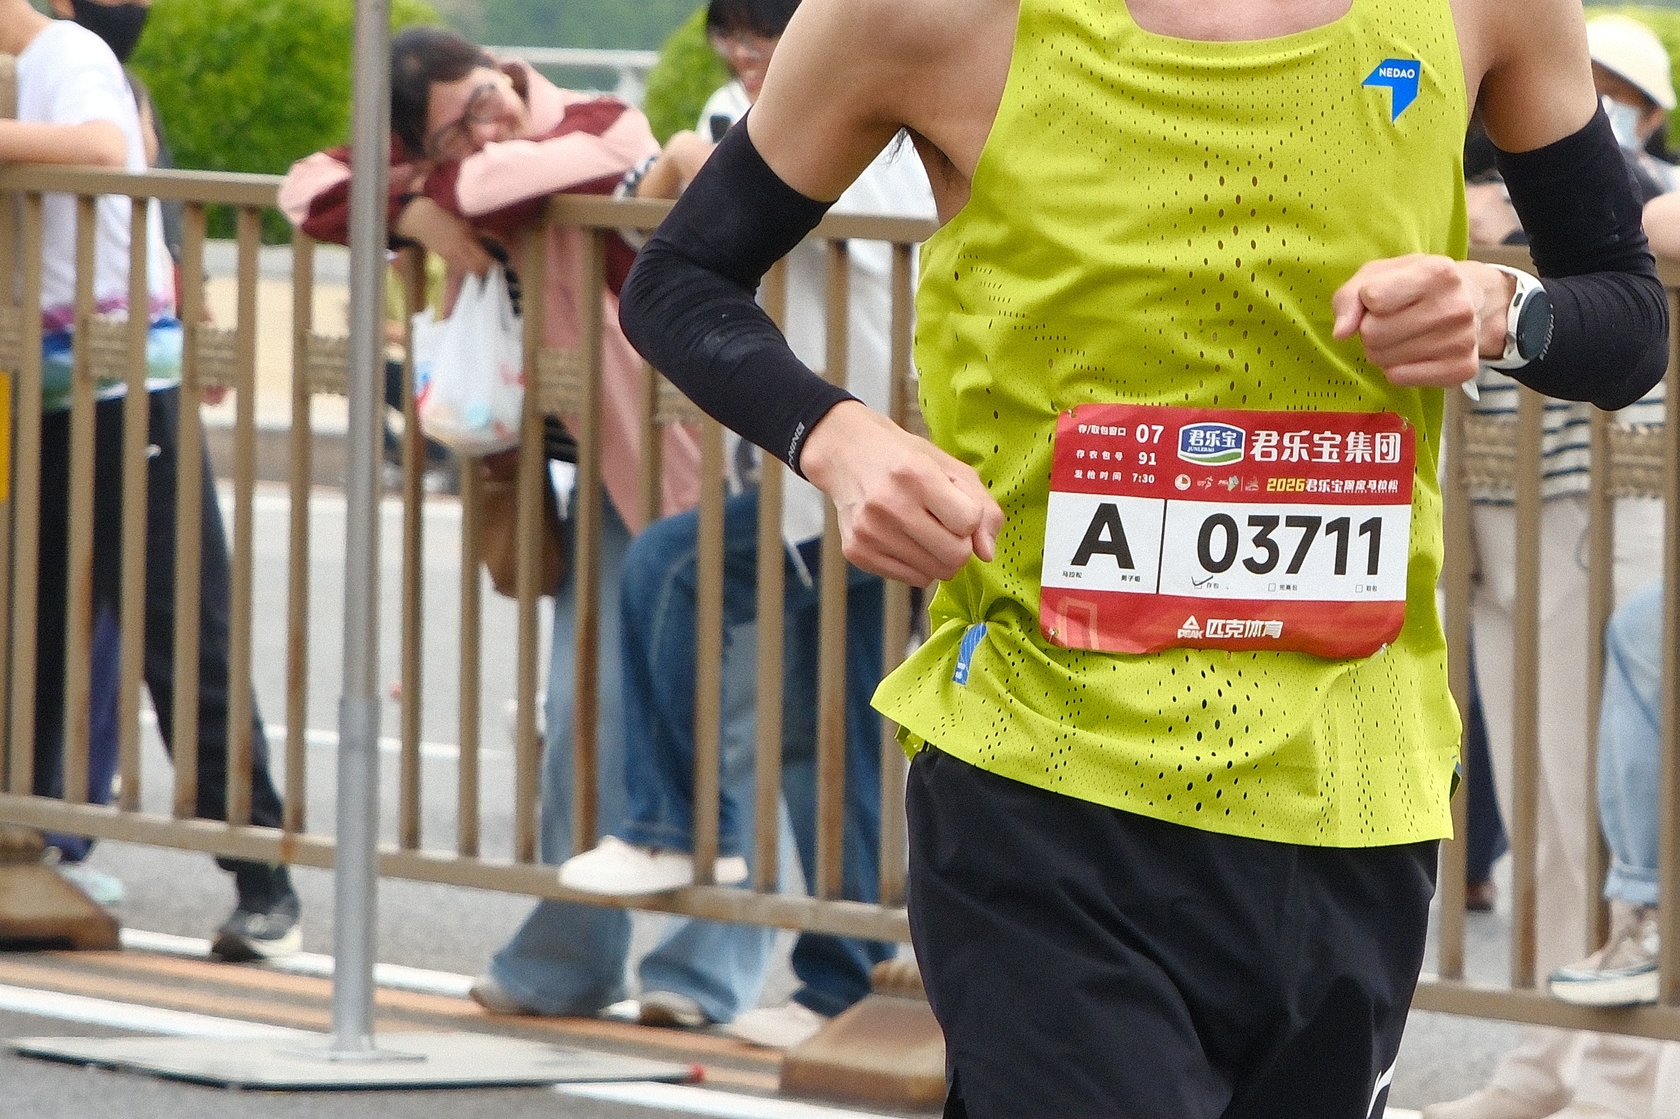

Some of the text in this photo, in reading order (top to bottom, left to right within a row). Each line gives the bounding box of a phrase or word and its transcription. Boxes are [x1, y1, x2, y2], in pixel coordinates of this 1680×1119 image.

[1379, 67, 1416, 79] NEDAO
[1135, 423, 1164, 444] 07
[1188, 429, 1237, 448] 君乐宝
[1249, 429, 1401, 464] 君乐宝集团
[1076, 449, 1157, 466] 存衣包号 91
[1074, 469, 1155, 484] 发枪时间 7:30
[1070, 502, 1135, 570] A
[1197, 513, 1383, 576] 03711
[1062, 570, 1083, 579] 马拉松
[1177, 629, 1204, 640] PEAK
[1205, 619, 1284, 639] 匹克体育
